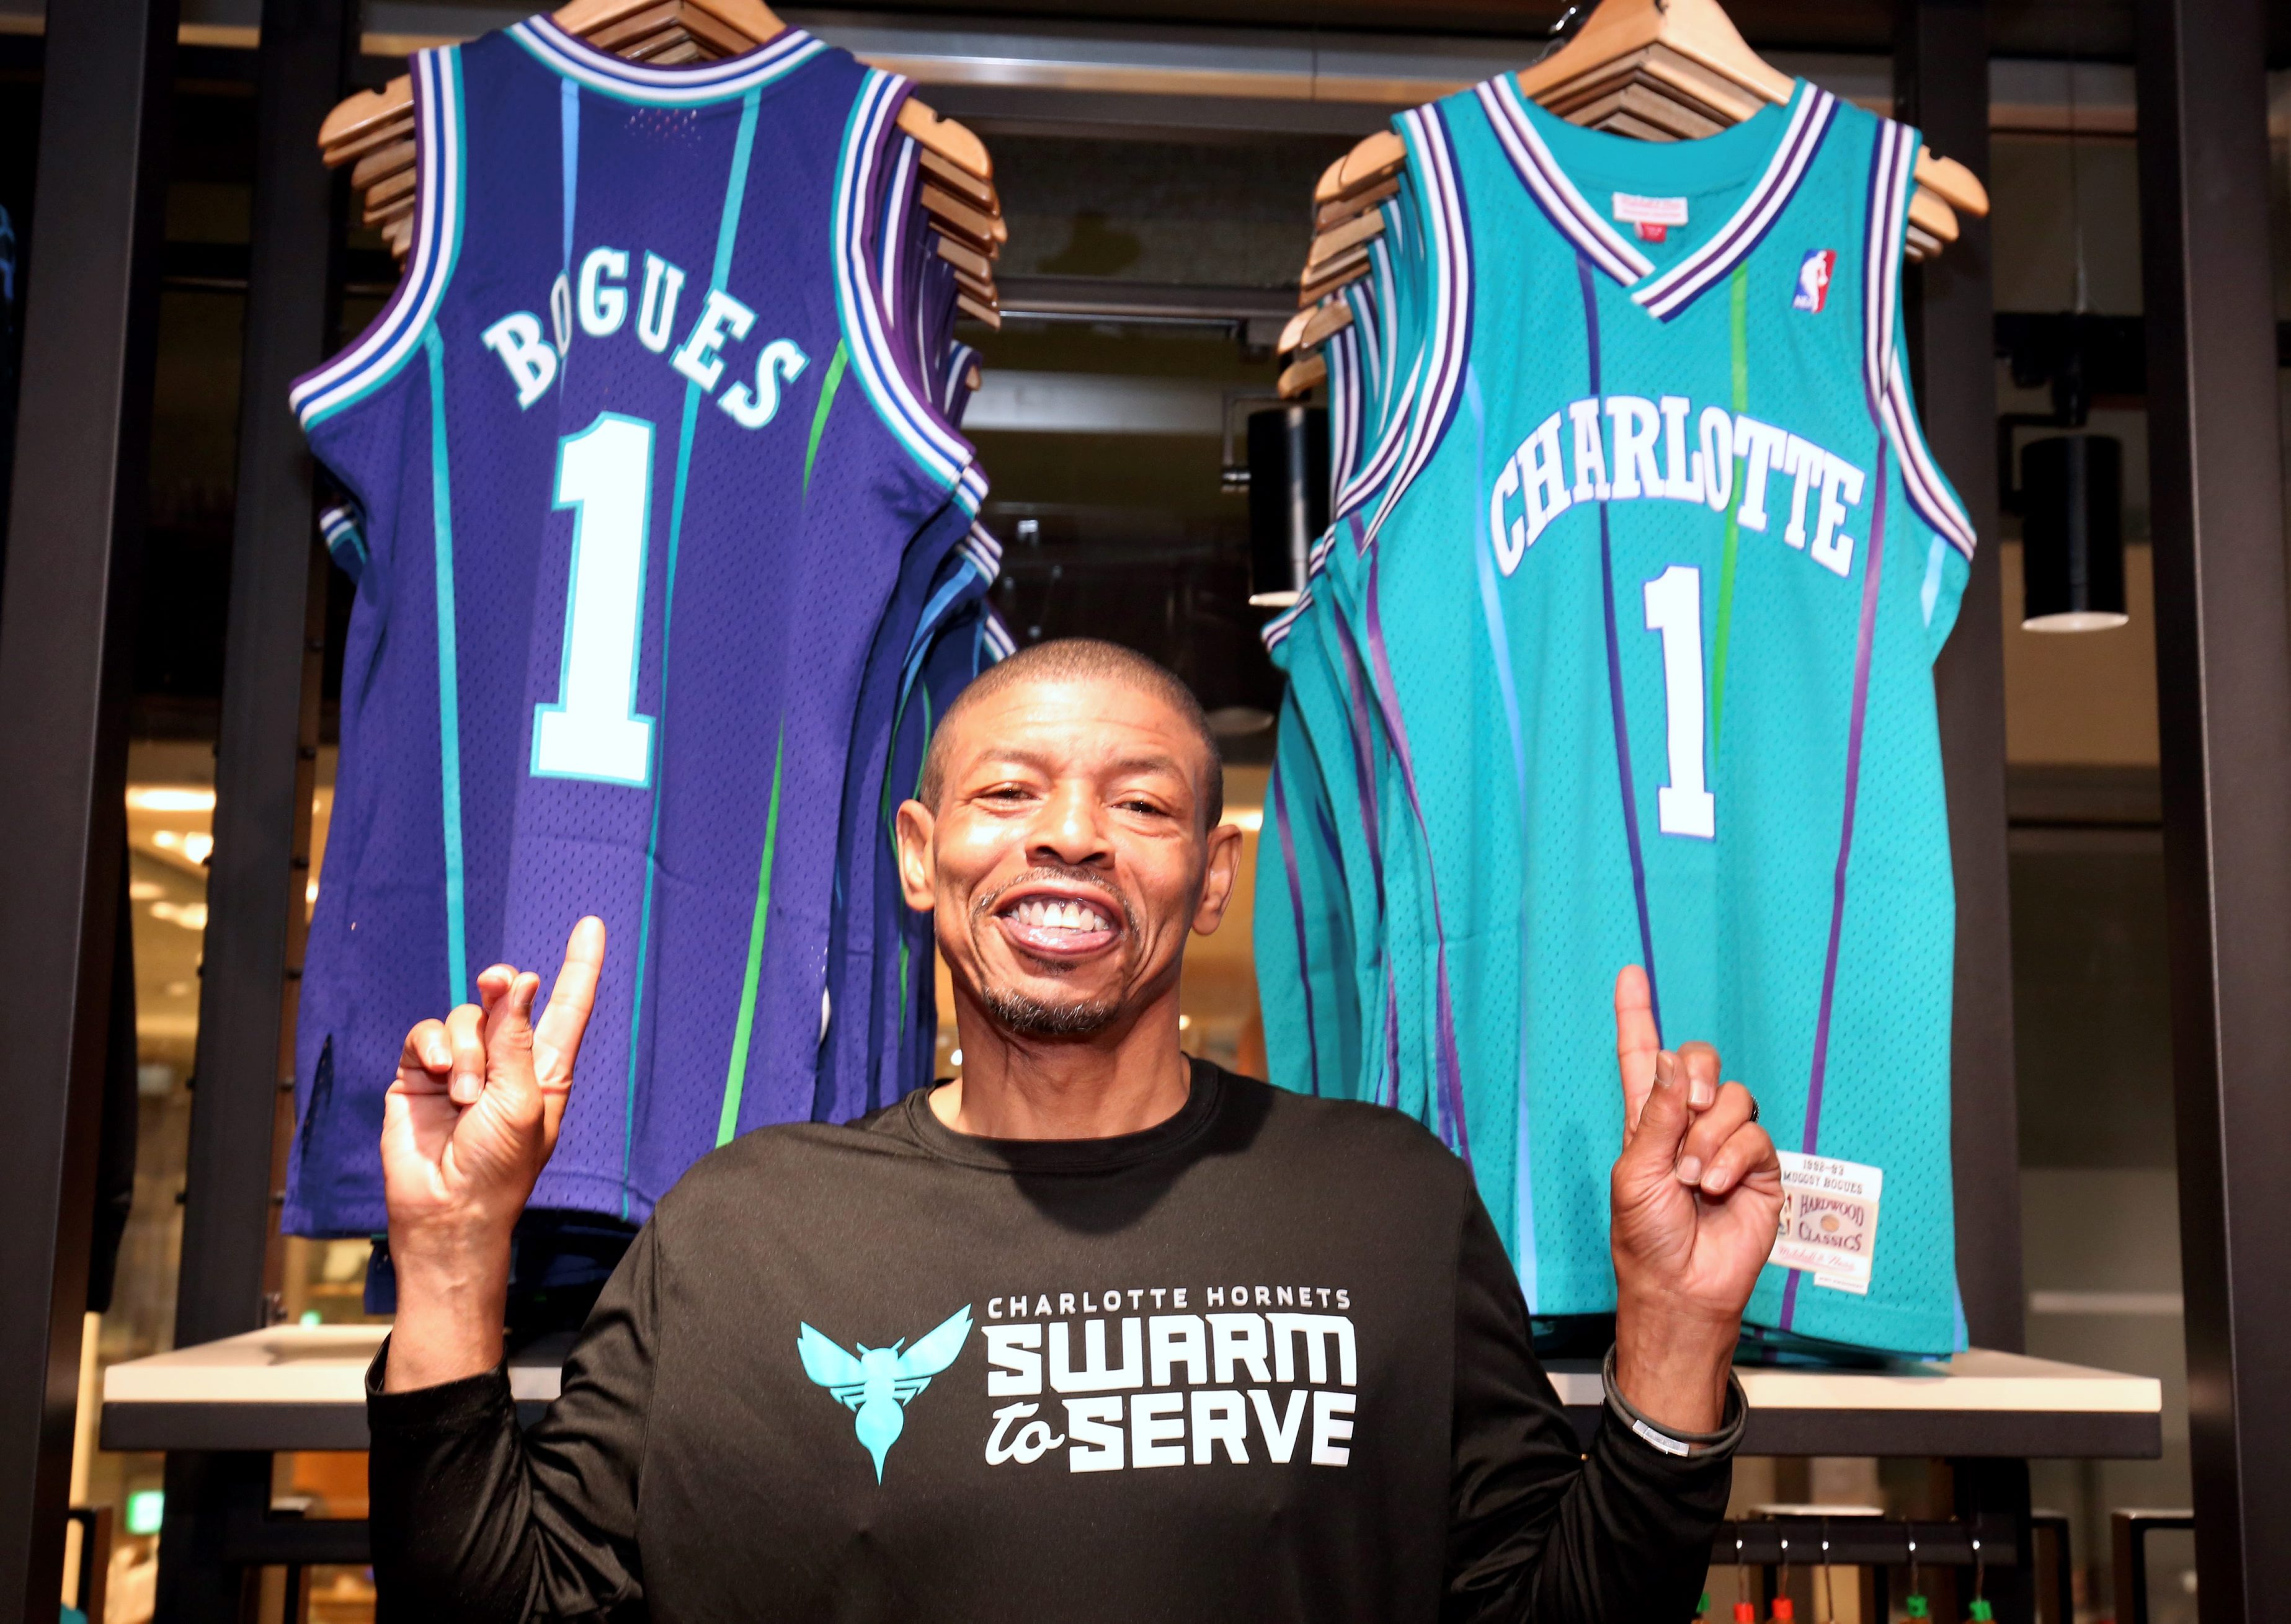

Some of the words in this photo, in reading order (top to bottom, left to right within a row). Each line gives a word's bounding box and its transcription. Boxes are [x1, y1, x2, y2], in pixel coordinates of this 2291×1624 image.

[481, 246, 811, 430] BOGUES
[1490, 395, 1866, 578] CHARLOTTE
[530, 410, 657, 789] 1
[1642, 563, 1715, 841] 1
[1800, 1194, 1864, 1227] HARDWOOD
[1823, 1177, 1863, 1194] BOGUES
[988, 1287, 1187, 1319] CHARLOTTE
[1207, 1285, 1351, 1310] HORNETS
[981, 1313, 1358, 1396] SWARM
[984, 1401, 1065, 1466] to
[1062, 1389, 1358, 1473] SERVE
